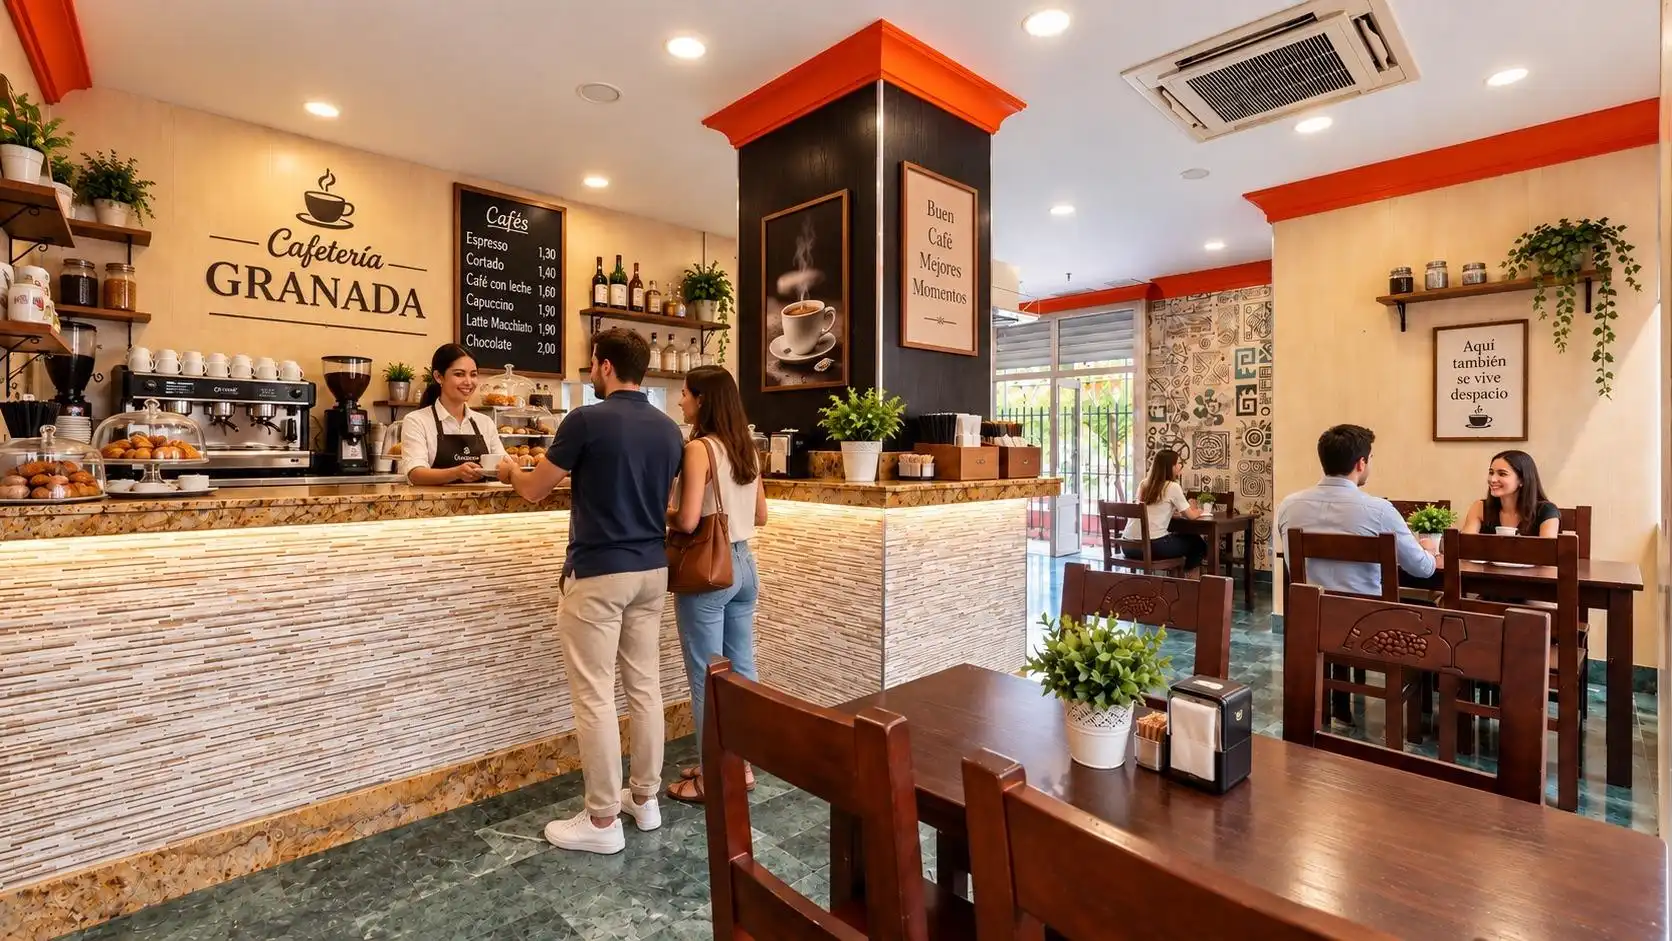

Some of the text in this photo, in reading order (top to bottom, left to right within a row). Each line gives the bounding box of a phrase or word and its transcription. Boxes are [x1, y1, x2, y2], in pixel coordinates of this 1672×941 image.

[486, 206, 529, 232] Cafés
[927, 199, 955, 224] Buen
[267, 227, 384, 270] Cafetería
[466, 231, 556, 261] Espresso 1,30
[466, 252, 556, 280] Cortado 1,40
[919, 251, 962, 279] Mejores
[205, 260, 426, 319] GRANADA
[466, 272, 556, 299] Café con leche 1,60
[912, 277, 967, 305] Momentos
[466, 292, 556, 318] Capuccino 1,90
[466, 314, 556, 337] Latte Macchiato 1,90
[466, 333, 556, 356] Chocolate 2,00
[1463, 338, 1495, 355] Aquí
[1453, 355, 1506, 369] también
[1457, 372, 1501, 385] se vive
[1450, 387, 1508, 403] despacio
